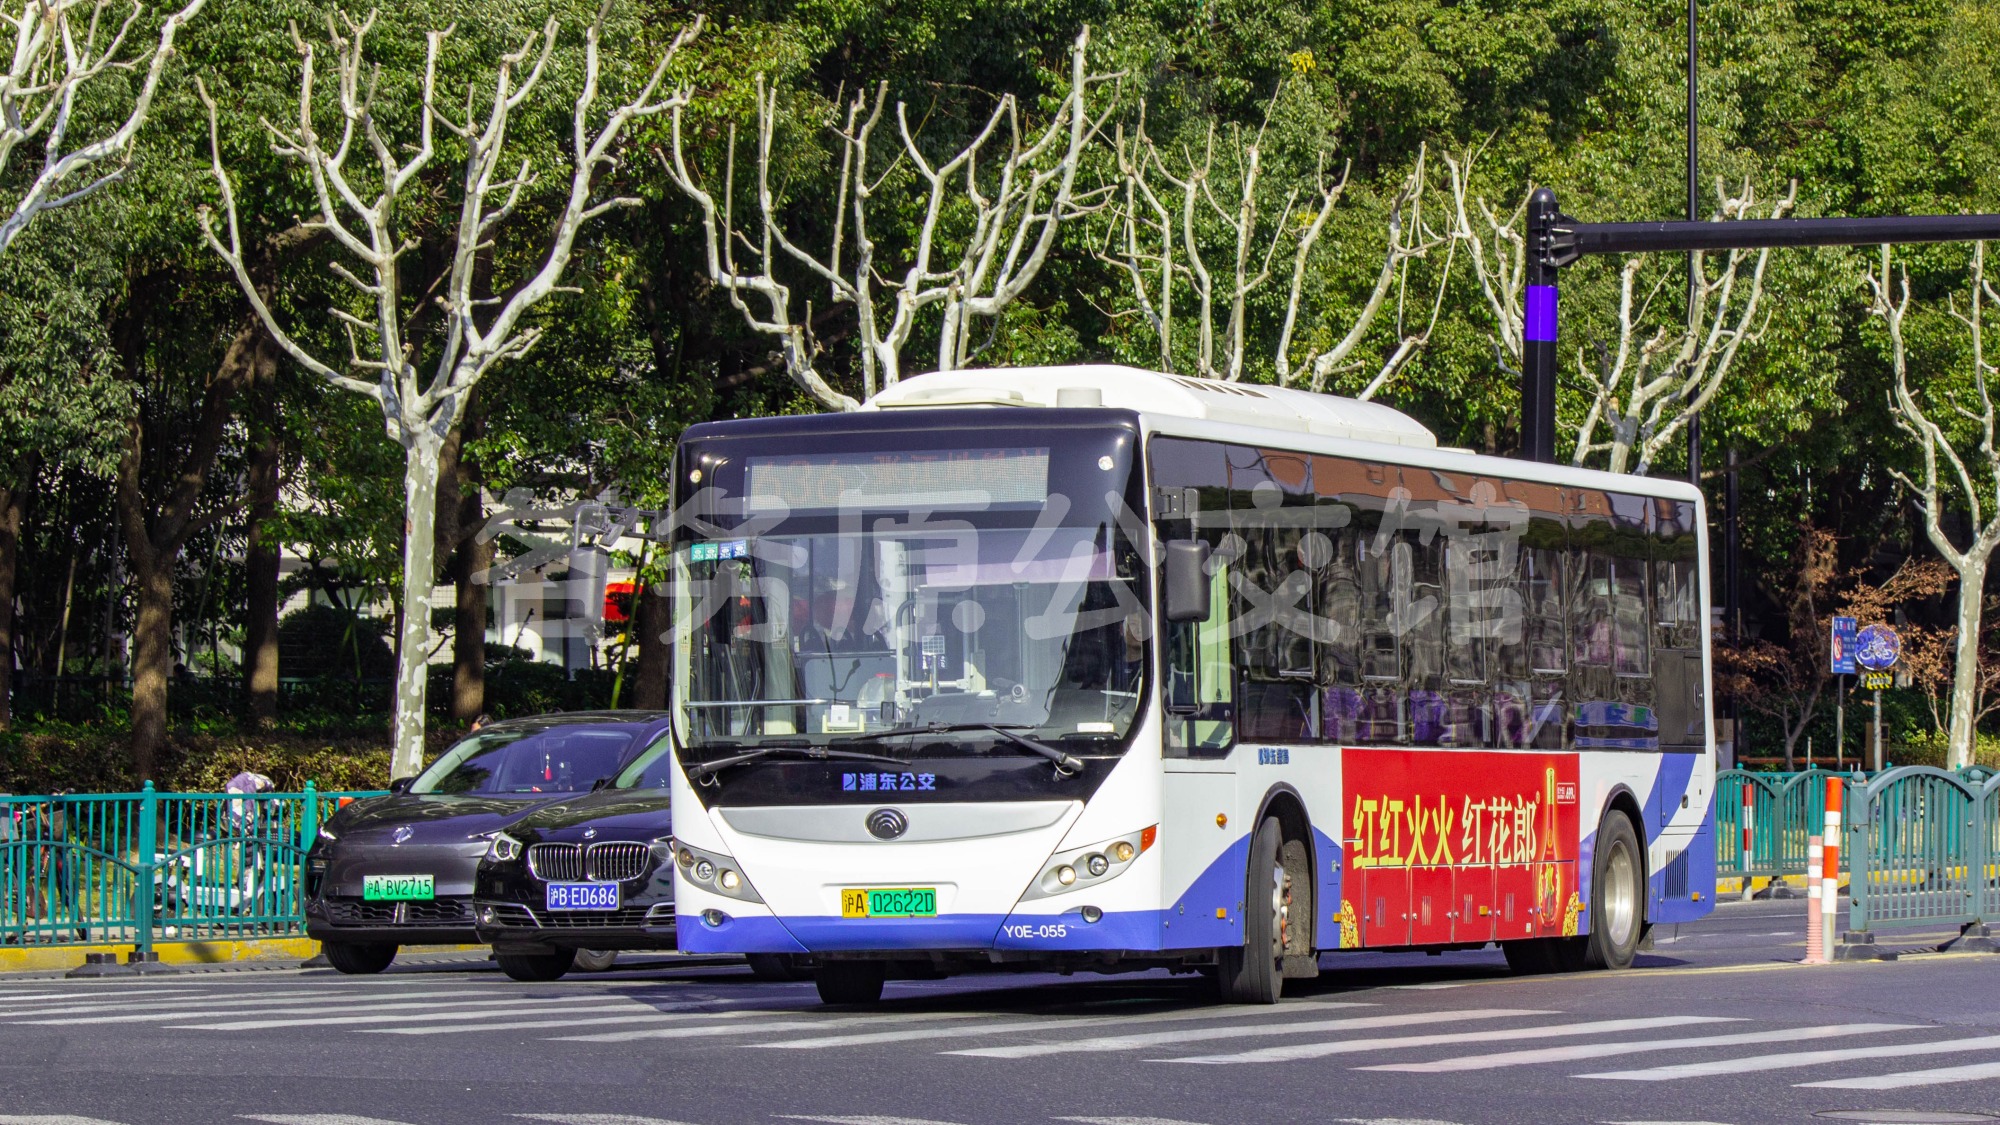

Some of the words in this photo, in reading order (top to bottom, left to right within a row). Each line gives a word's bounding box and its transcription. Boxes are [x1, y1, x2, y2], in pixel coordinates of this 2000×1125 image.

[859, 772, 936, 791] 浦东公交
[1352, 793, 1454, 872] 红红火火
[1461, 793, 1537, 872] 红花郎
